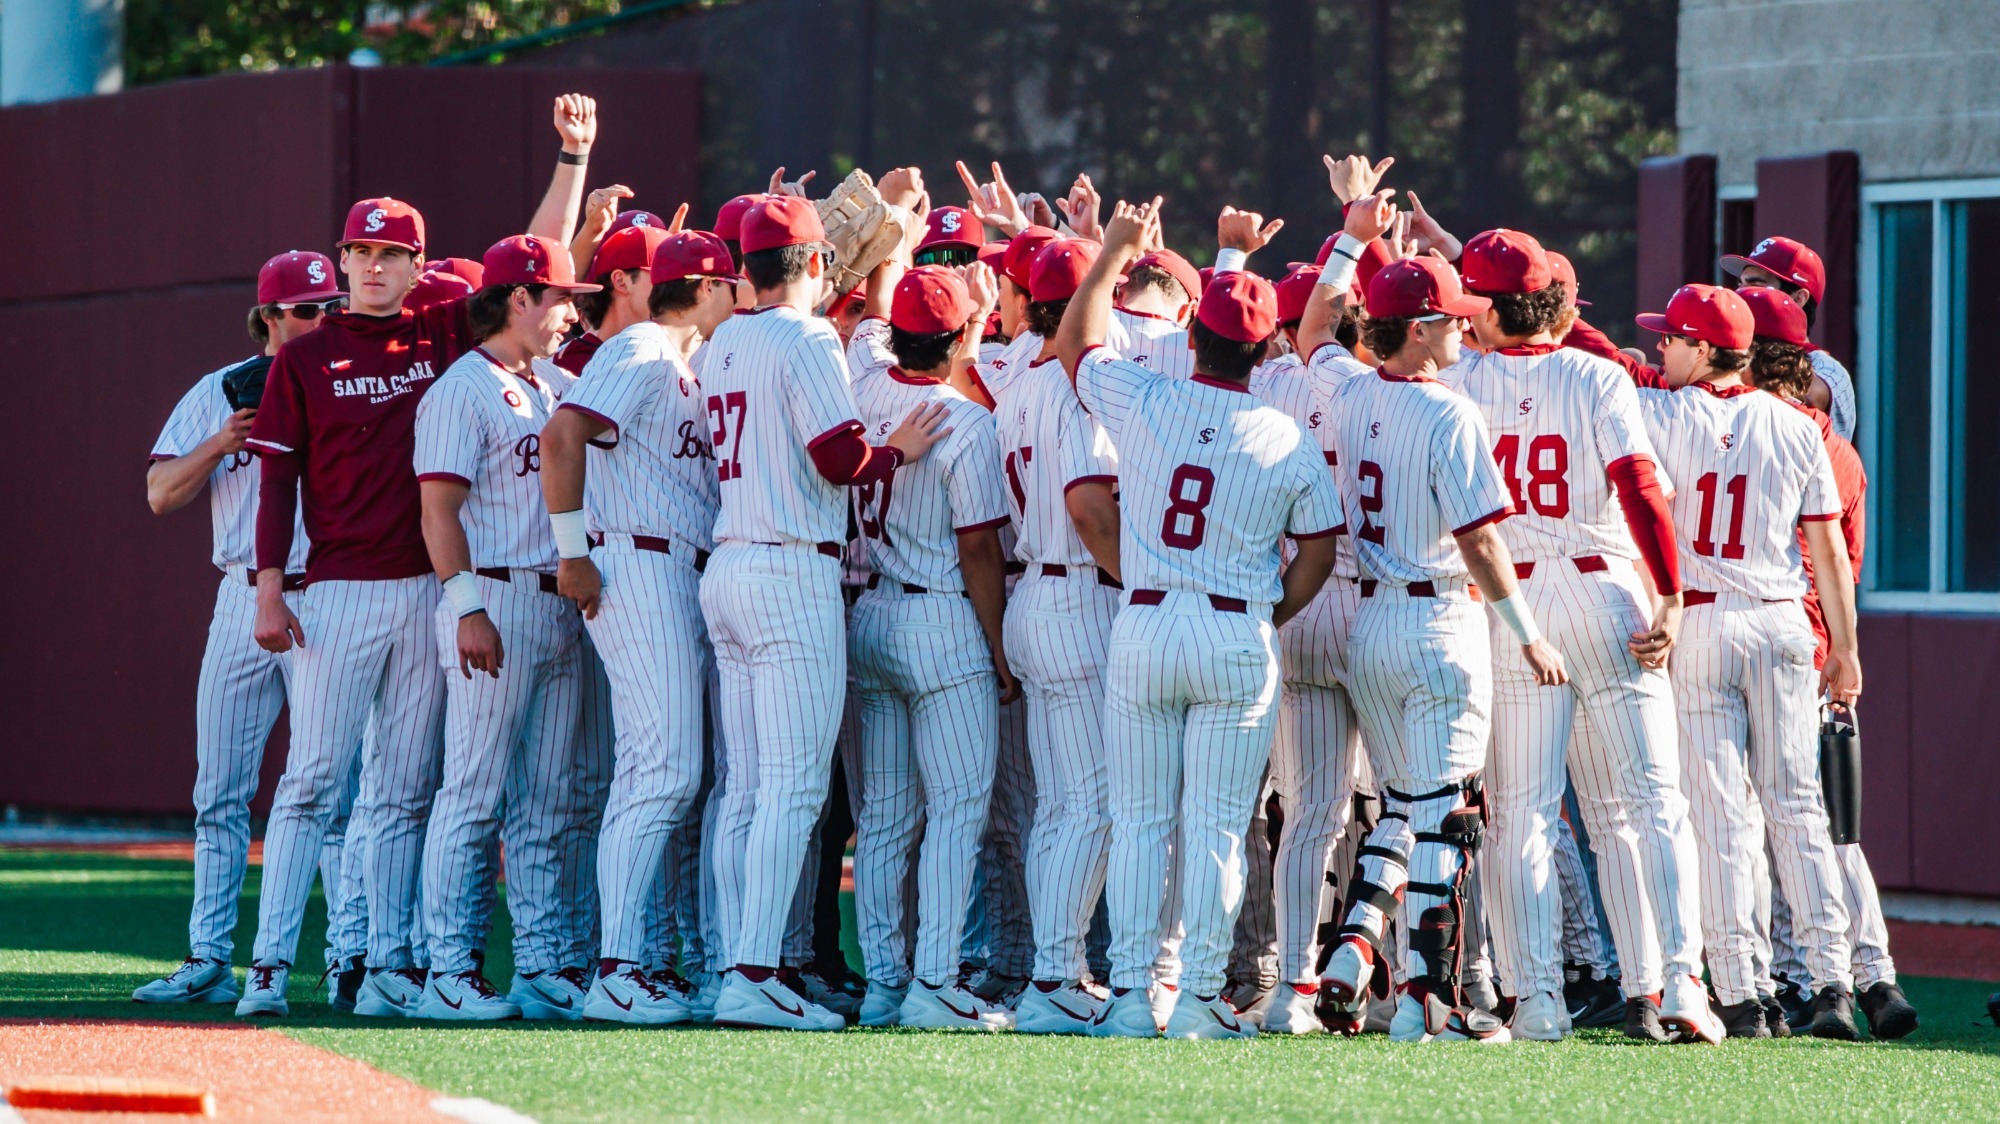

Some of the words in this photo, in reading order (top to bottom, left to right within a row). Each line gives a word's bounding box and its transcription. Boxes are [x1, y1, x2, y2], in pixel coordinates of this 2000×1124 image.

[332, 376, 389, 397] SANTA
[389, 360, 435, 392] CLARA
[707, 390, 748, 482] 27
[1492, 434, 1570, 520] 48
[1160, 462, 1216, 551] 8
[1358, 459, 1386, 549] 2
[1692, 471, 1748, 560] 11
